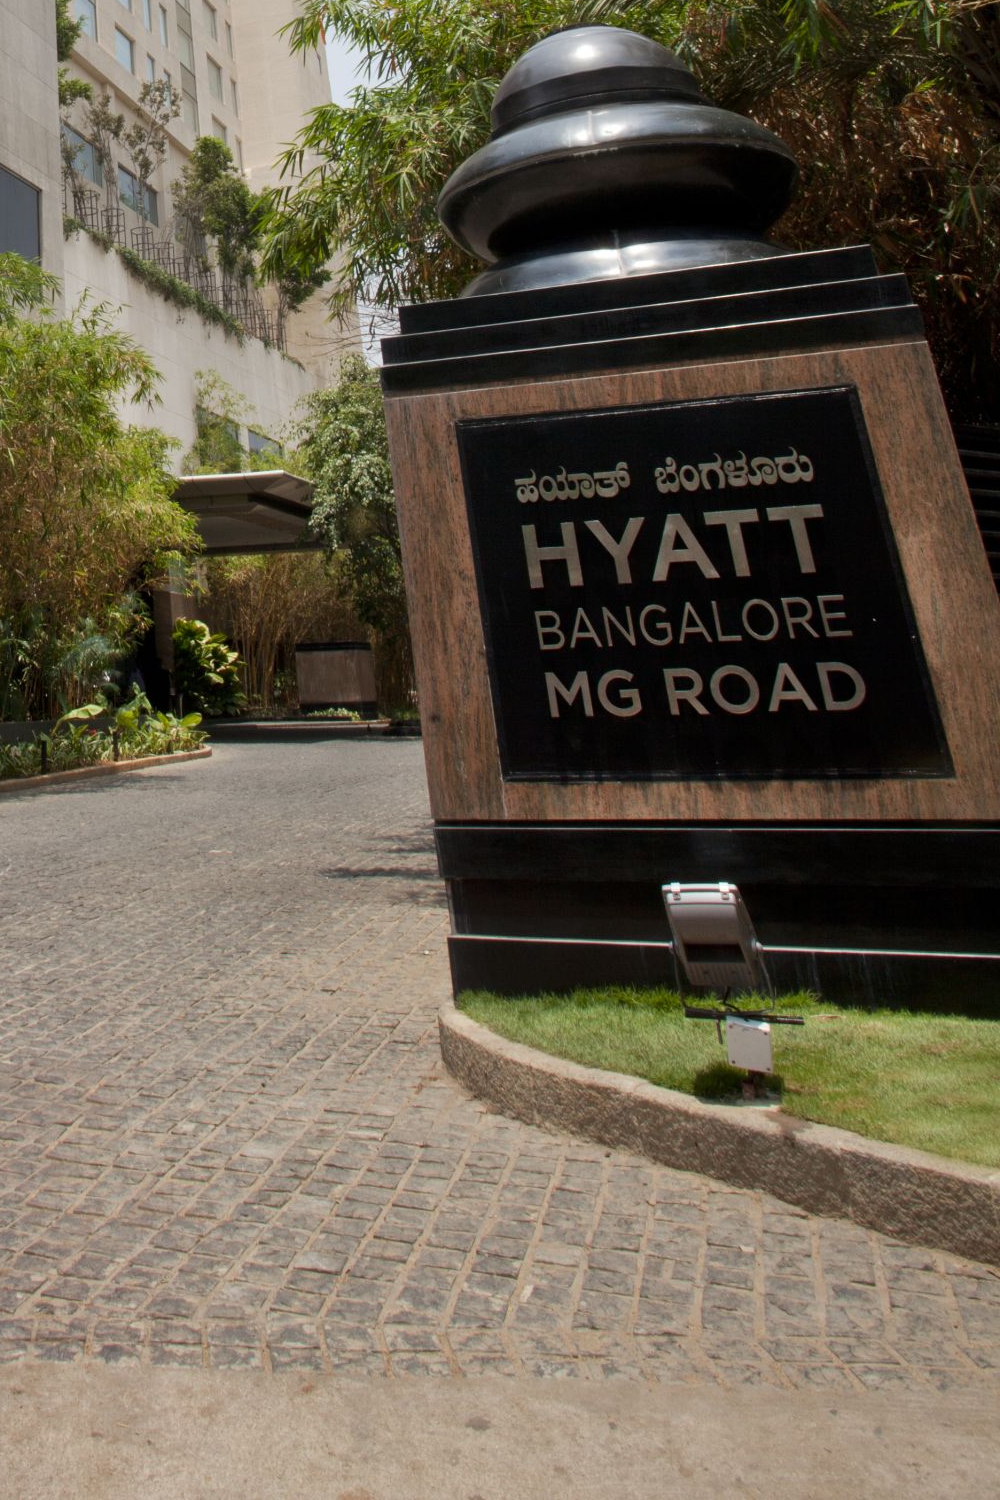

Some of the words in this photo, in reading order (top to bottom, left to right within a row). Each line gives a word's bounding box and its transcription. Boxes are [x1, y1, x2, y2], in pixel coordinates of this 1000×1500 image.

[514, 461, 631, 504] ಹಯಾತ್
[654, 446, 814, 494] ಬೆಂಗಳೂರು
[521, 503, 824, 589] HYATT
[534, 594, 853, 650] BANGALORE
[544, 669, 643, 718] MG
[663, 661, 866, 715] ROAD
